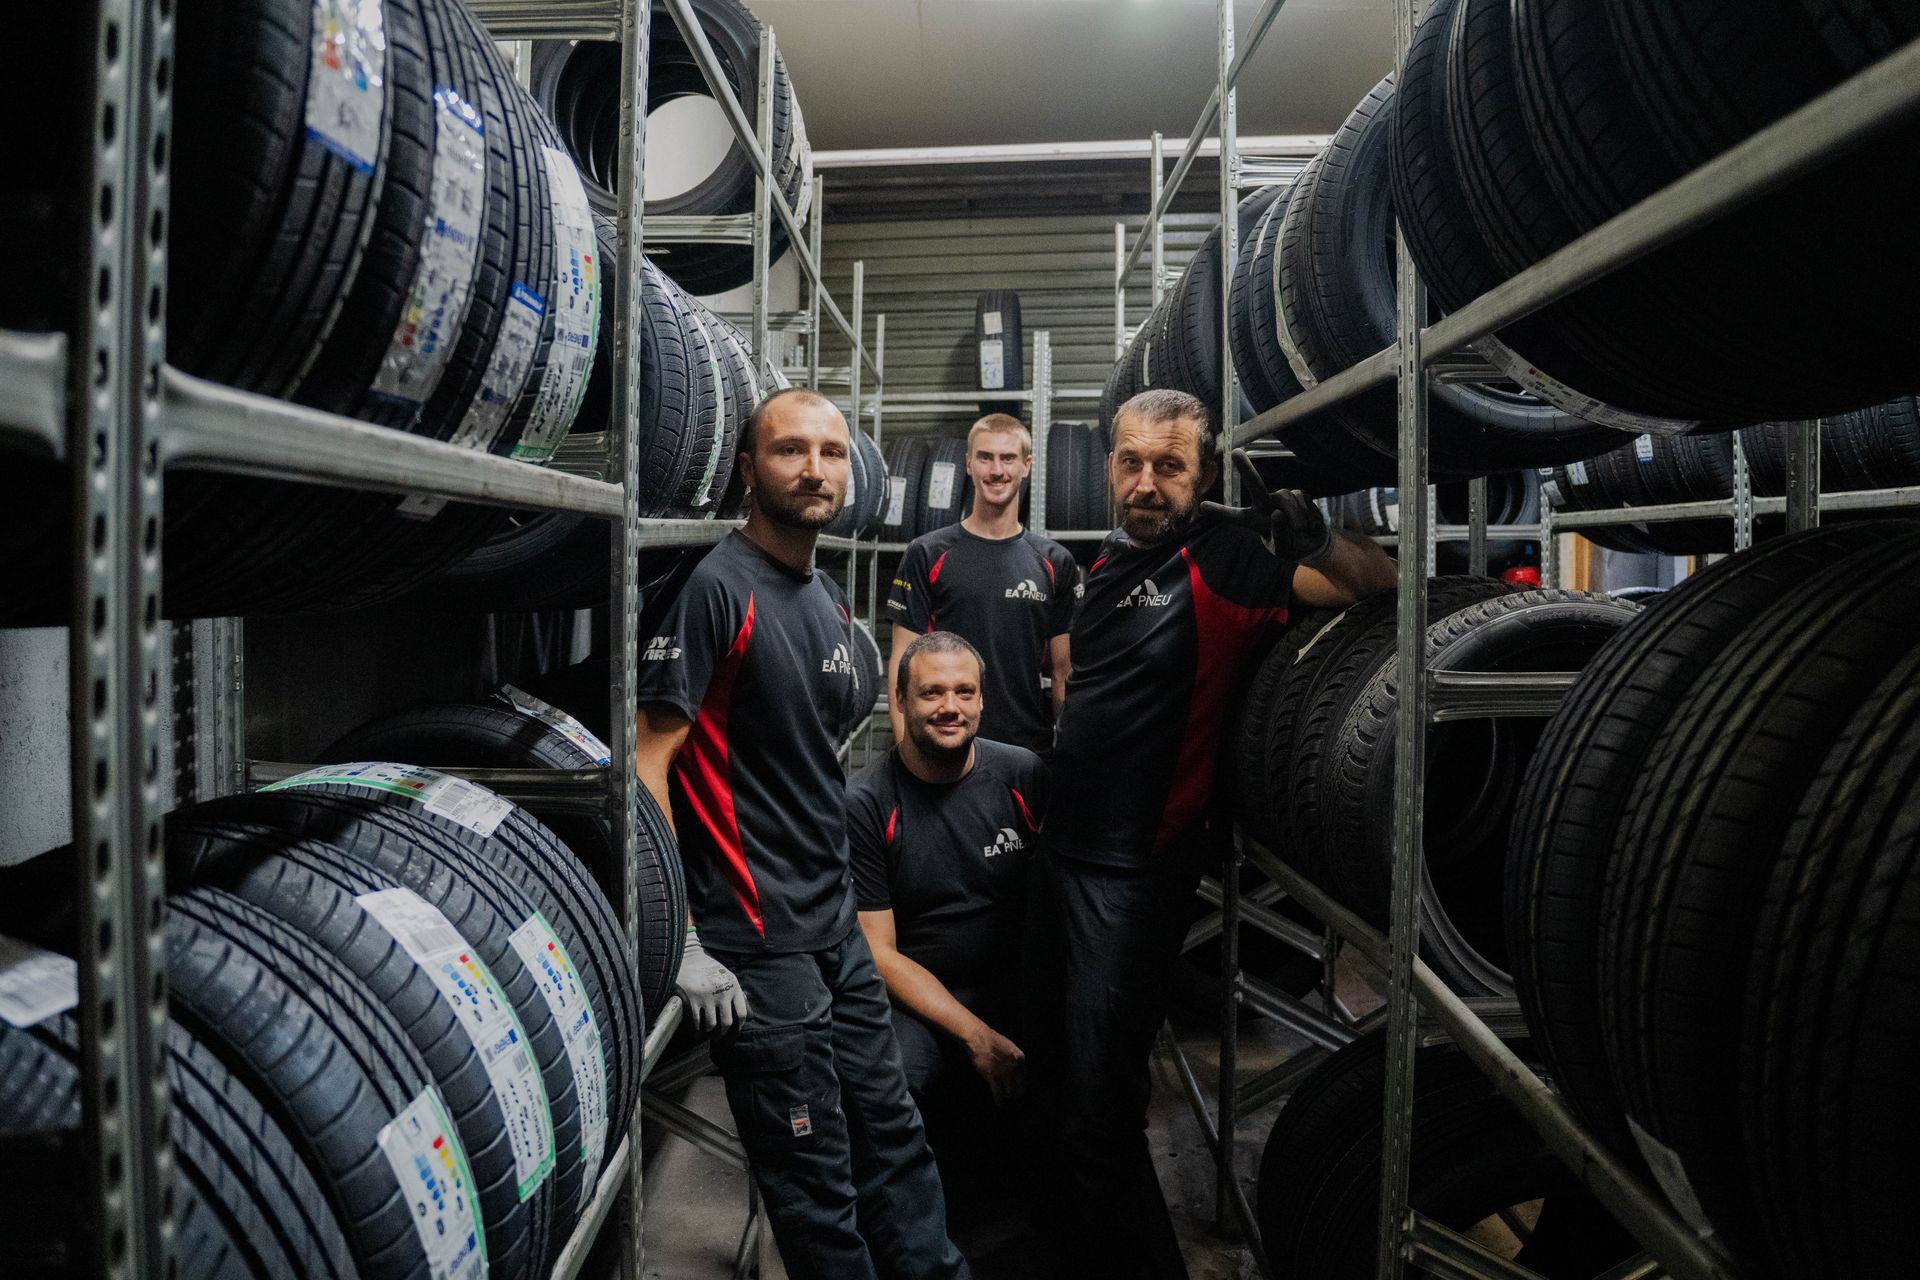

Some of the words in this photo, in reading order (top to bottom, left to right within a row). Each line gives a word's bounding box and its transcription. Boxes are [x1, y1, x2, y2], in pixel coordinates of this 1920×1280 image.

[1005, 589, 1019, 598] EA
[1022, 589, 1047, 602] PNEU
[1138, 594, 1172, 607] PNEU
[822, 659, 837, 673] EA
[839, 660, 851, 675] PNE
[983, 844, 1002, 858] EA
[1004, 838, 1025, 853] PNE
